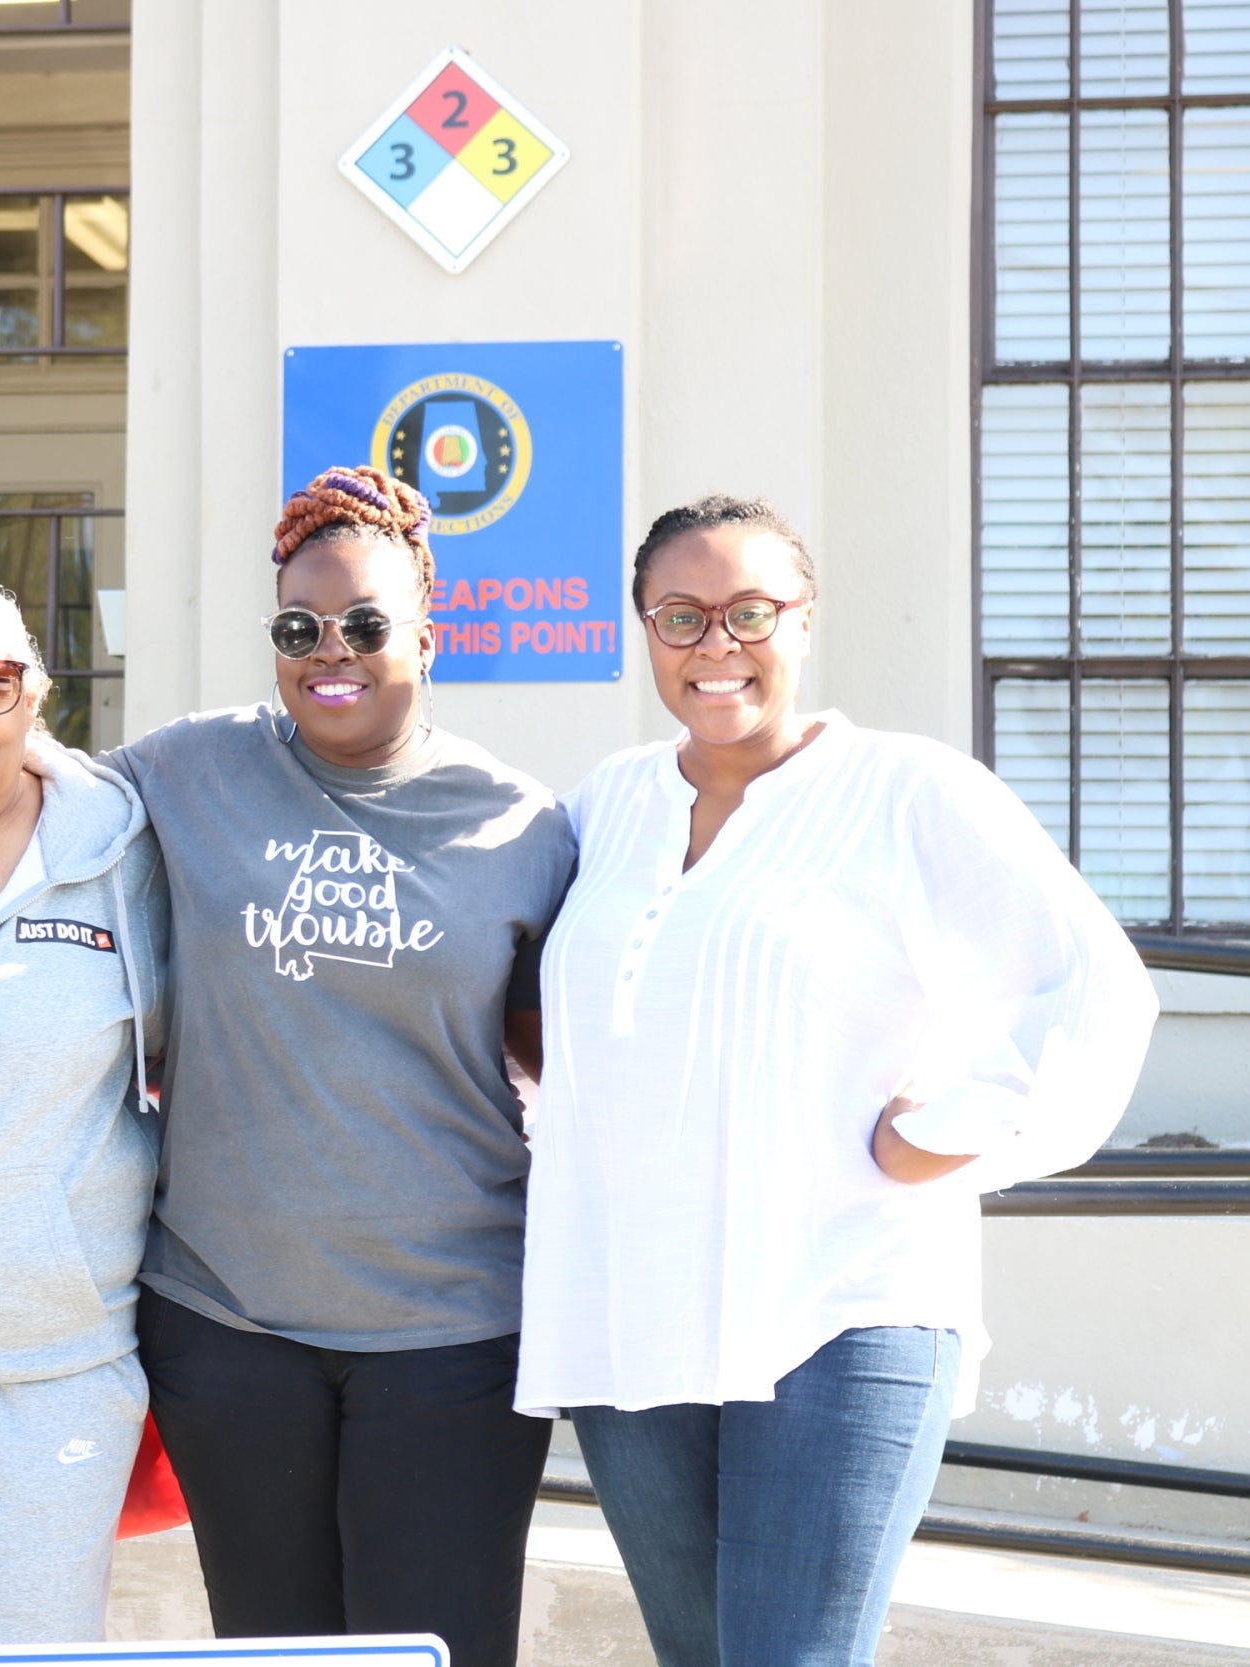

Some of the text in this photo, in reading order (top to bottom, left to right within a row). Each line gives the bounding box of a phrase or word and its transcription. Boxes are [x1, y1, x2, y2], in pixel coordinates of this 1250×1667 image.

[442, 90, 468, 129] 2
[390, 142, 416, 180] 3
[492, 137, 518, 175] 3
[382, 376, 523, 426] DEPARTMENT OF
[429, 577, 589, 612] EAPONS
[435, 620, 617, 655] THIS POINT!
[265, 835, 415, 874] make
[289, 873, 396, 912] good
[18, 922, 96, 947] JUST DO IT.
[240, 902, 445, 951] trouble
[66, 1437, 96, 1456] NIKE
